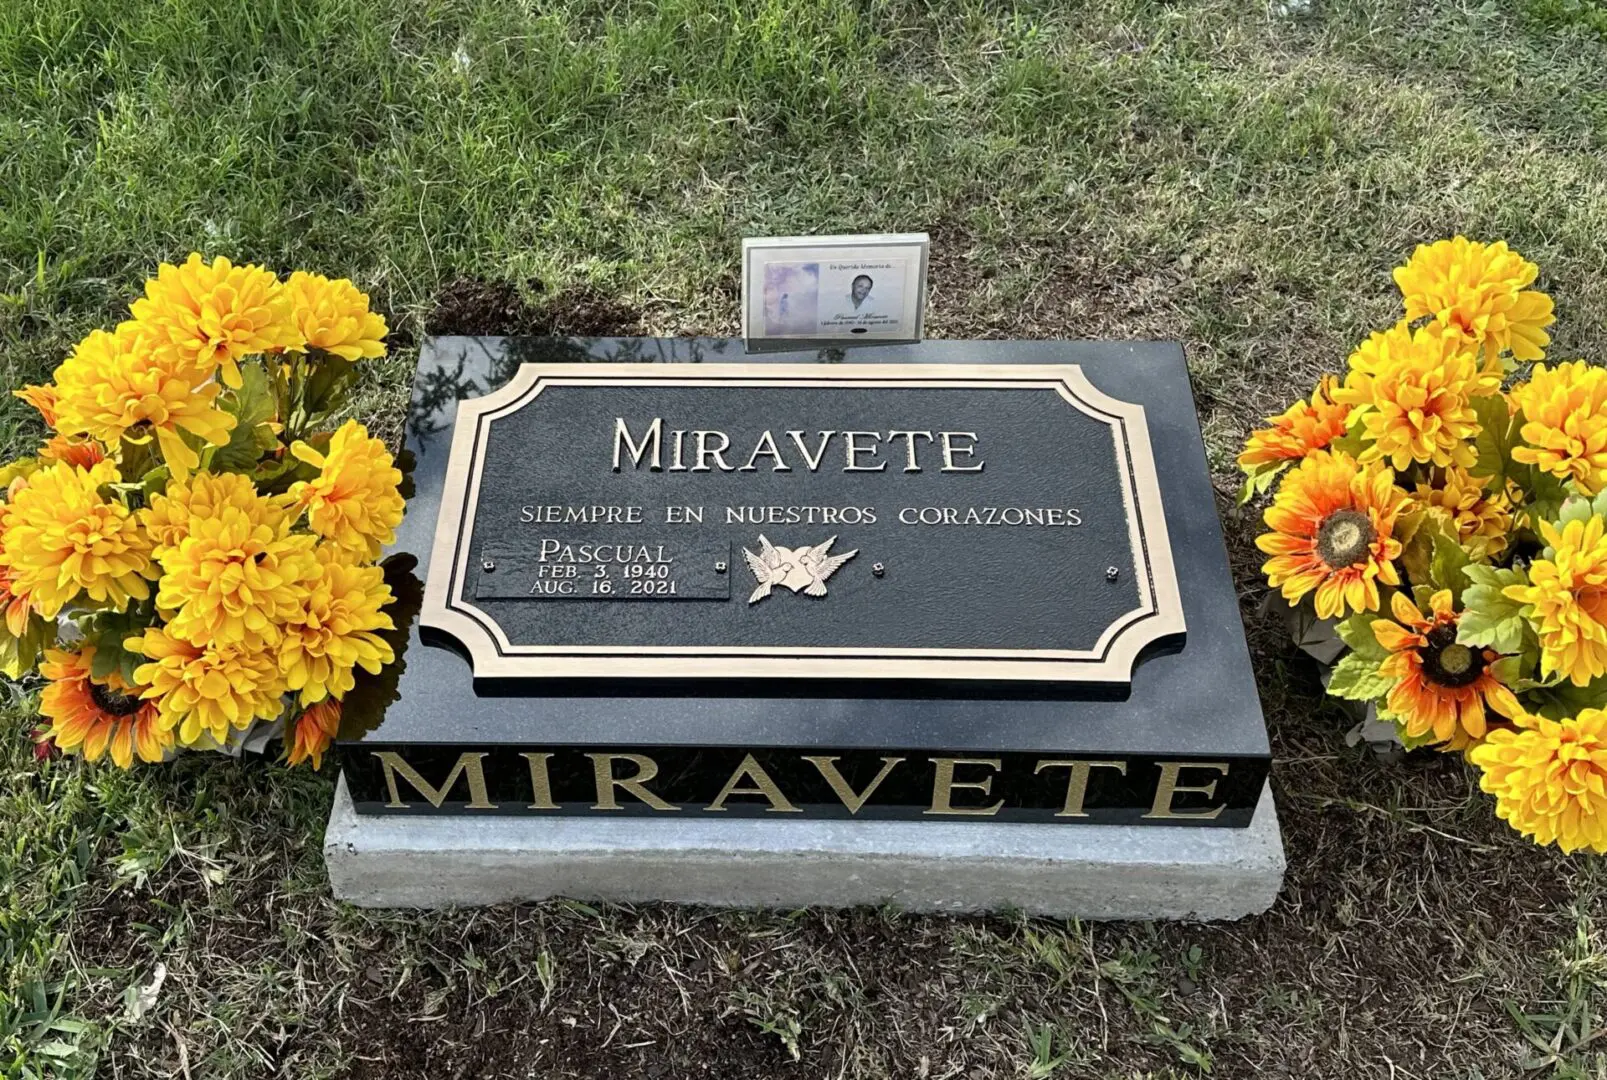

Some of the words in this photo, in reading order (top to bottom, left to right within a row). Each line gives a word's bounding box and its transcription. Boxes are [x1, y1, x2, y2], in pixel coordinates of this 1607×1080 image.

[612, 417, 985, 473] MIRAVETE
[520, 505, 643, 523] SIEMPRE
[666, 506, 703, 523] EN
[726, 506, 877, 524] NUESTROS
[899, 507, 1082, 525] CORAZONES
[539, 538, 674, 563] PASCUAL
[538, 565, 581, 578] FEB.
[624, 565, 669, 578] 1940
[529, 580, 578, 594] AUG.
[630, 581, 677, 594] 2021
[370, 752, 1230, 819] MIRAVETE
